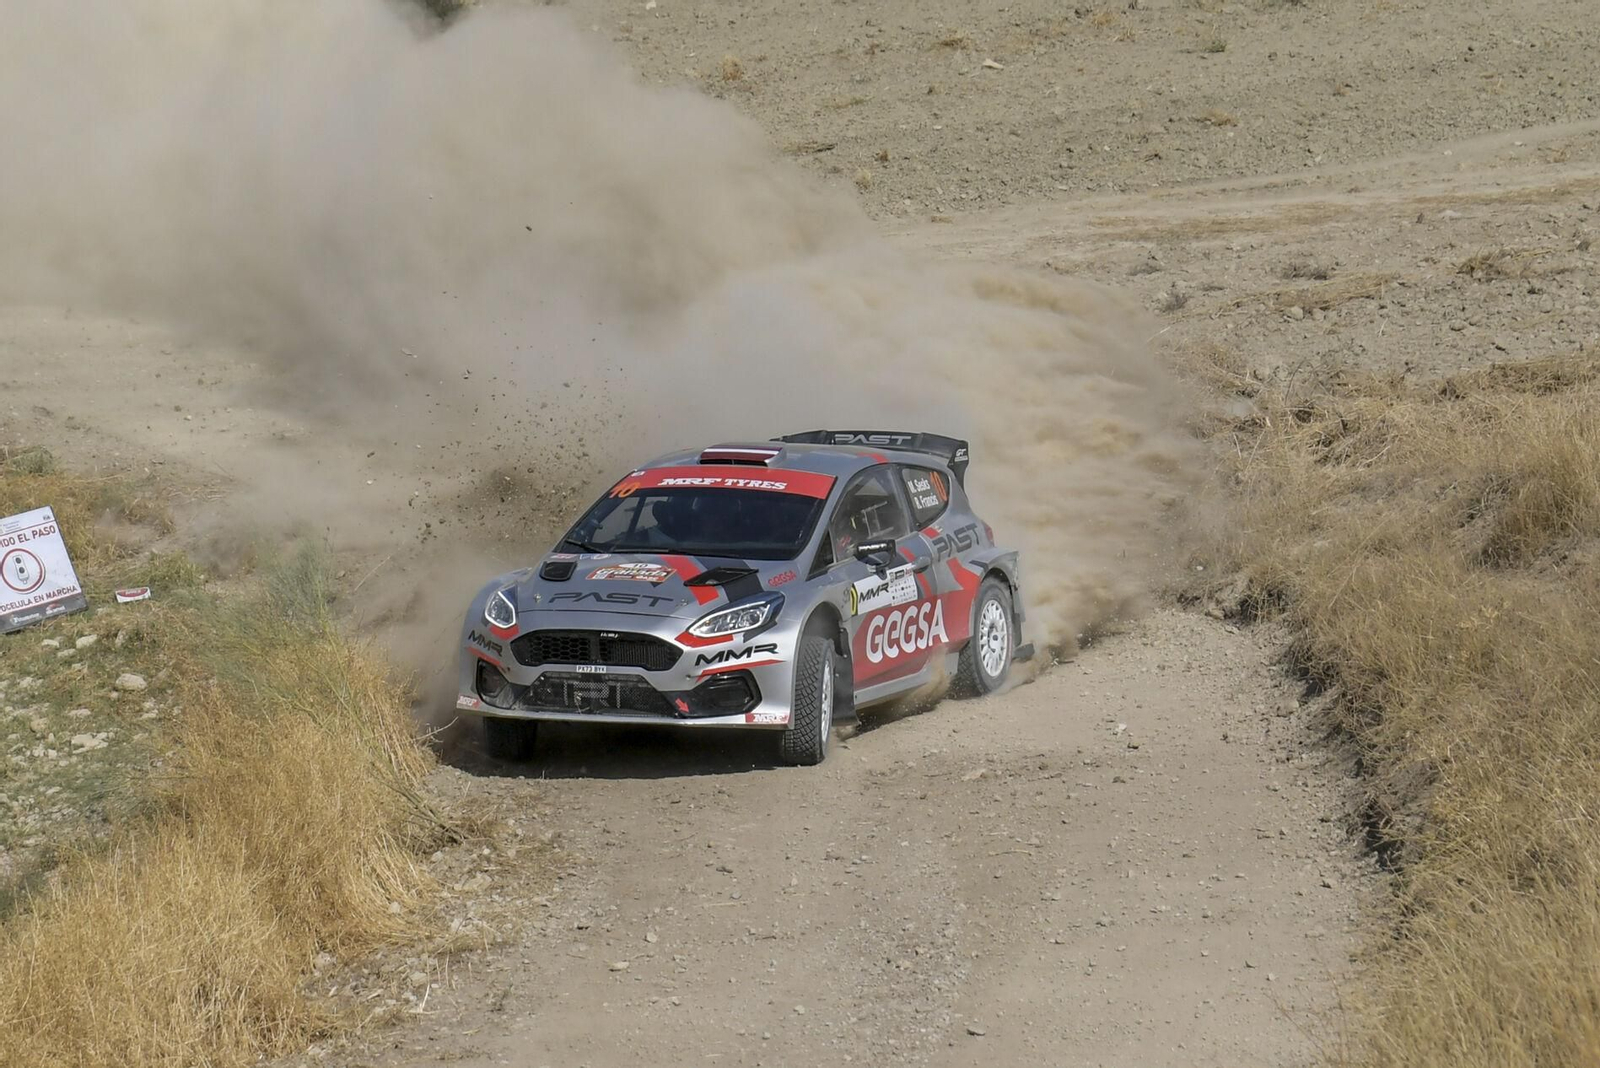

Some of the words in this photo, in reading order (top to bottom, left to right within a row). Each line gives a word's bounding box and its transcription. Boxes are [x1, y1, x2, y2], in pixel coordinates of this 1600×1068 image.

[834, 434, 912, 445] PAST
[609, 482, 640, 498] 10
[657, 478, 722, 486] MRF
[724, 478, 788, 490] TYRES
[17, 532, 31, 544] EL
[31, 525, 56, 539] PASO
[932, 523, 980, 563] PAST
[0, 598, 33, 612] OCELULA
[34, 595, 45, 603] EN
[46, 585, 78, 599] MARCHA
[548, 592, 674, 607] PAST
[858, 582, 890, 604] MMR
[468, 629, 504, 657] MMR
[694, 643, 780, 667] MMR
